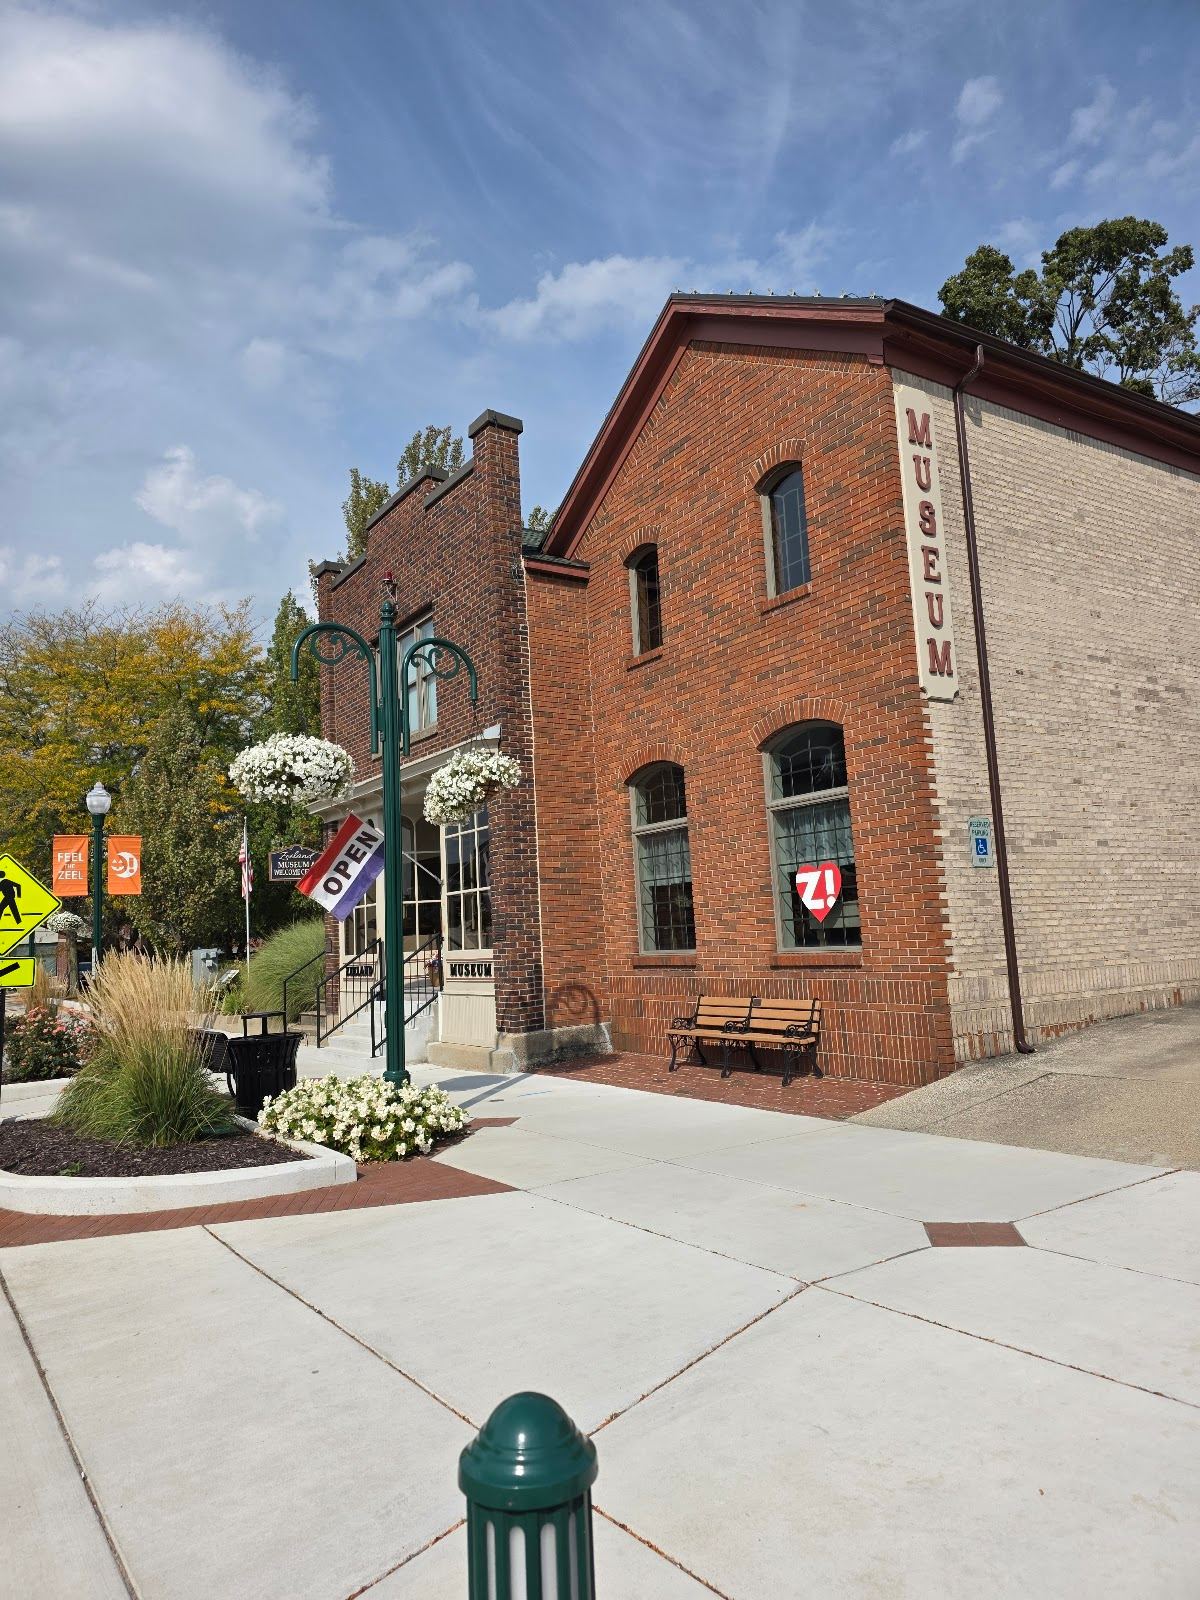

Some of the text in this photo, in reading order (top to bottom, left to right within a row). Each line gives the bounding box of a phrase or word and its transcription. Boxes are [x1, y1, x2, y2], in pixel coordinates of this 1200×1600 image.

[905, 407, 954, 678] MUSEUM
[57, 852, 84, 862] FEEL
[322, 830, 379, 895] OPEN
[58, 870, 83, 880] ZEEL
[273, 868, 301, 876] WELCOME
[450, 963, 493, 977] MUSEUM
